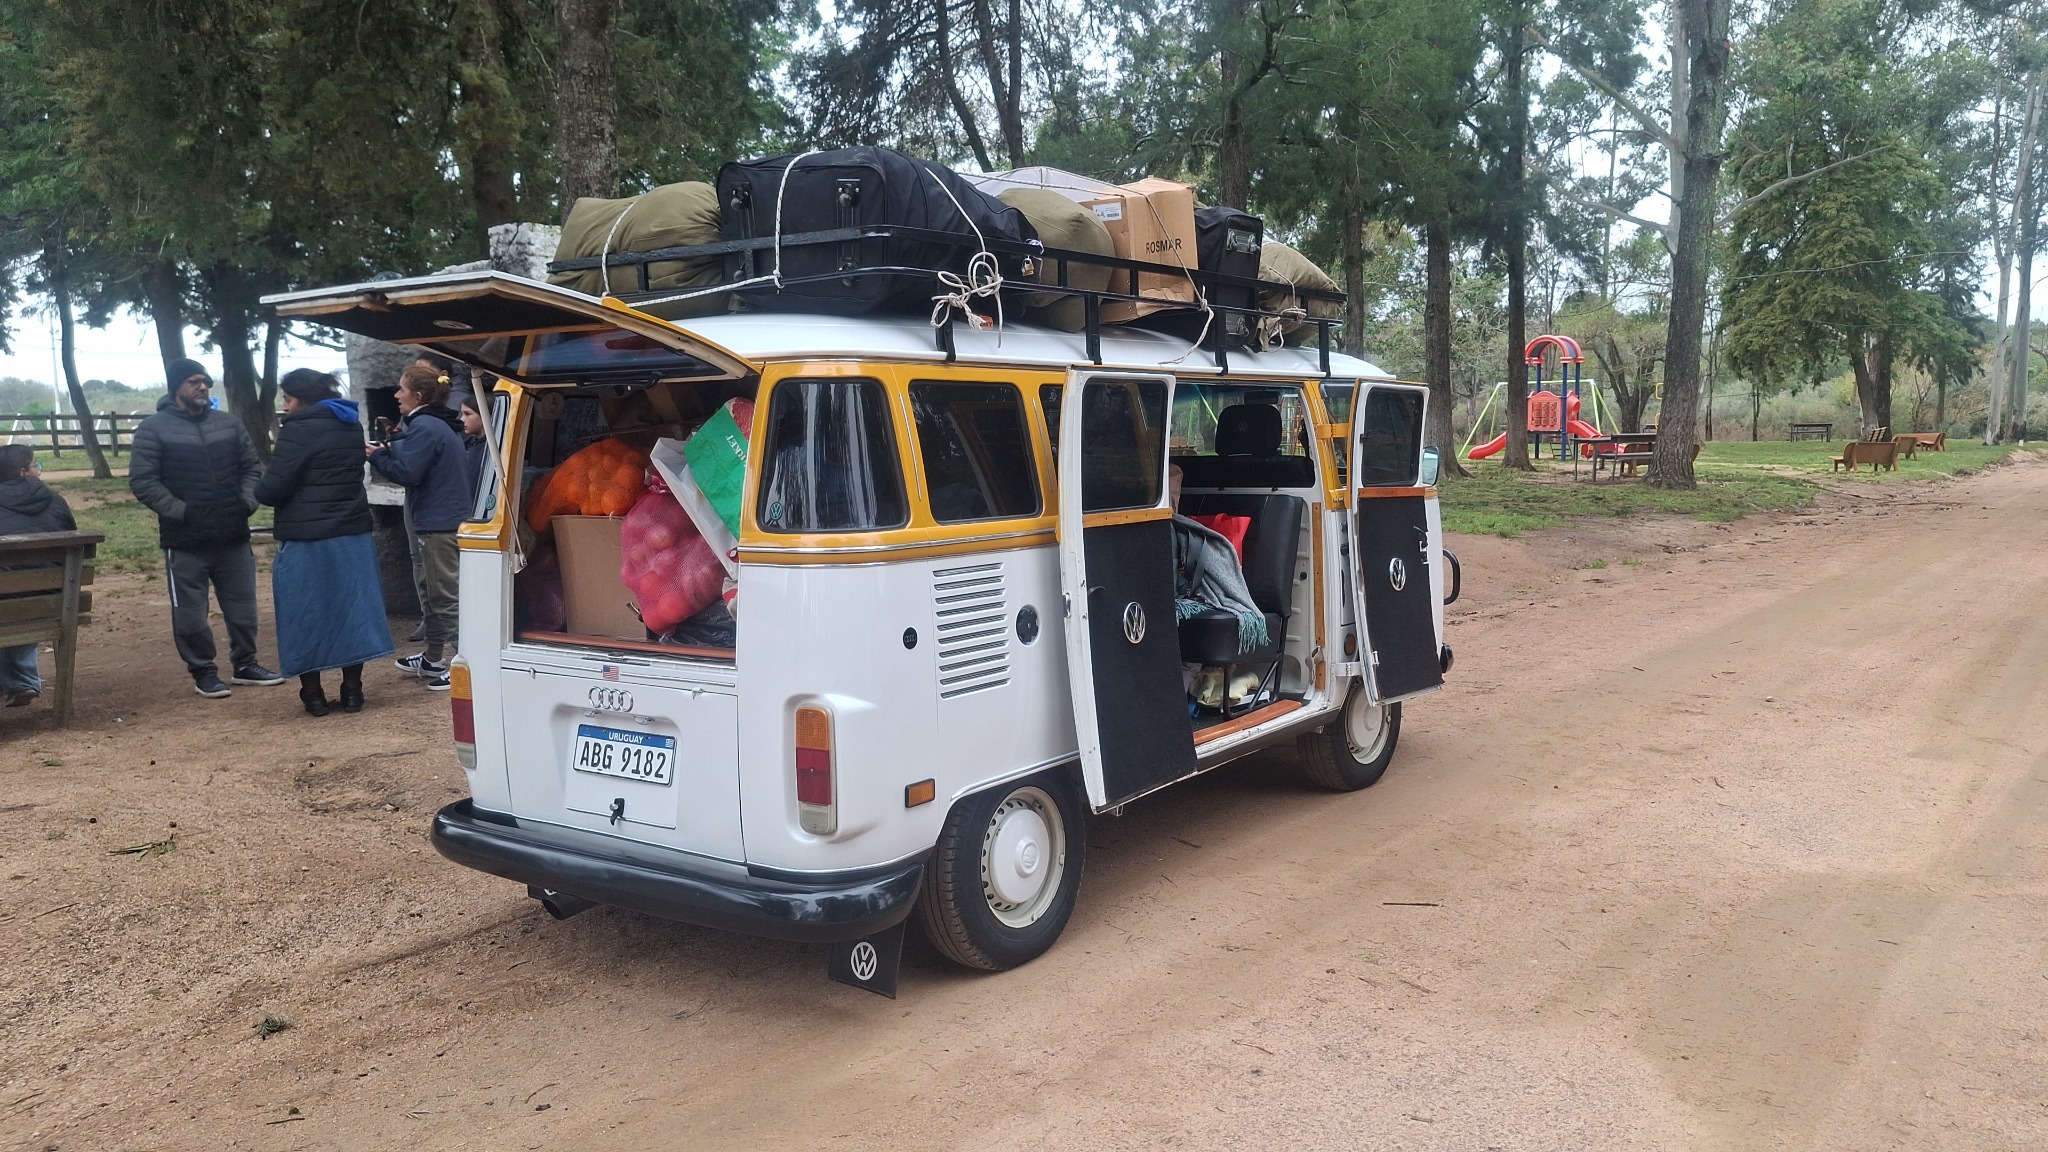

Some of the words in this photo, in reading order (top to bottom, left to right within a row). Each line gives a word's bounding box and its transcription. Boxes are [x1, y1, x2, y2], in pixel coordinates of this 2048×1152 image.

[1145, 238, 1182, 255] ROSMAR
[725, 434, 747, 467] RKET
[608, 731, 644, 744] URUGUAY
[579, 741, 614, 770] ABG
[620, 746, 667, 779] 9182
[850, 941, 877, 981] VW
